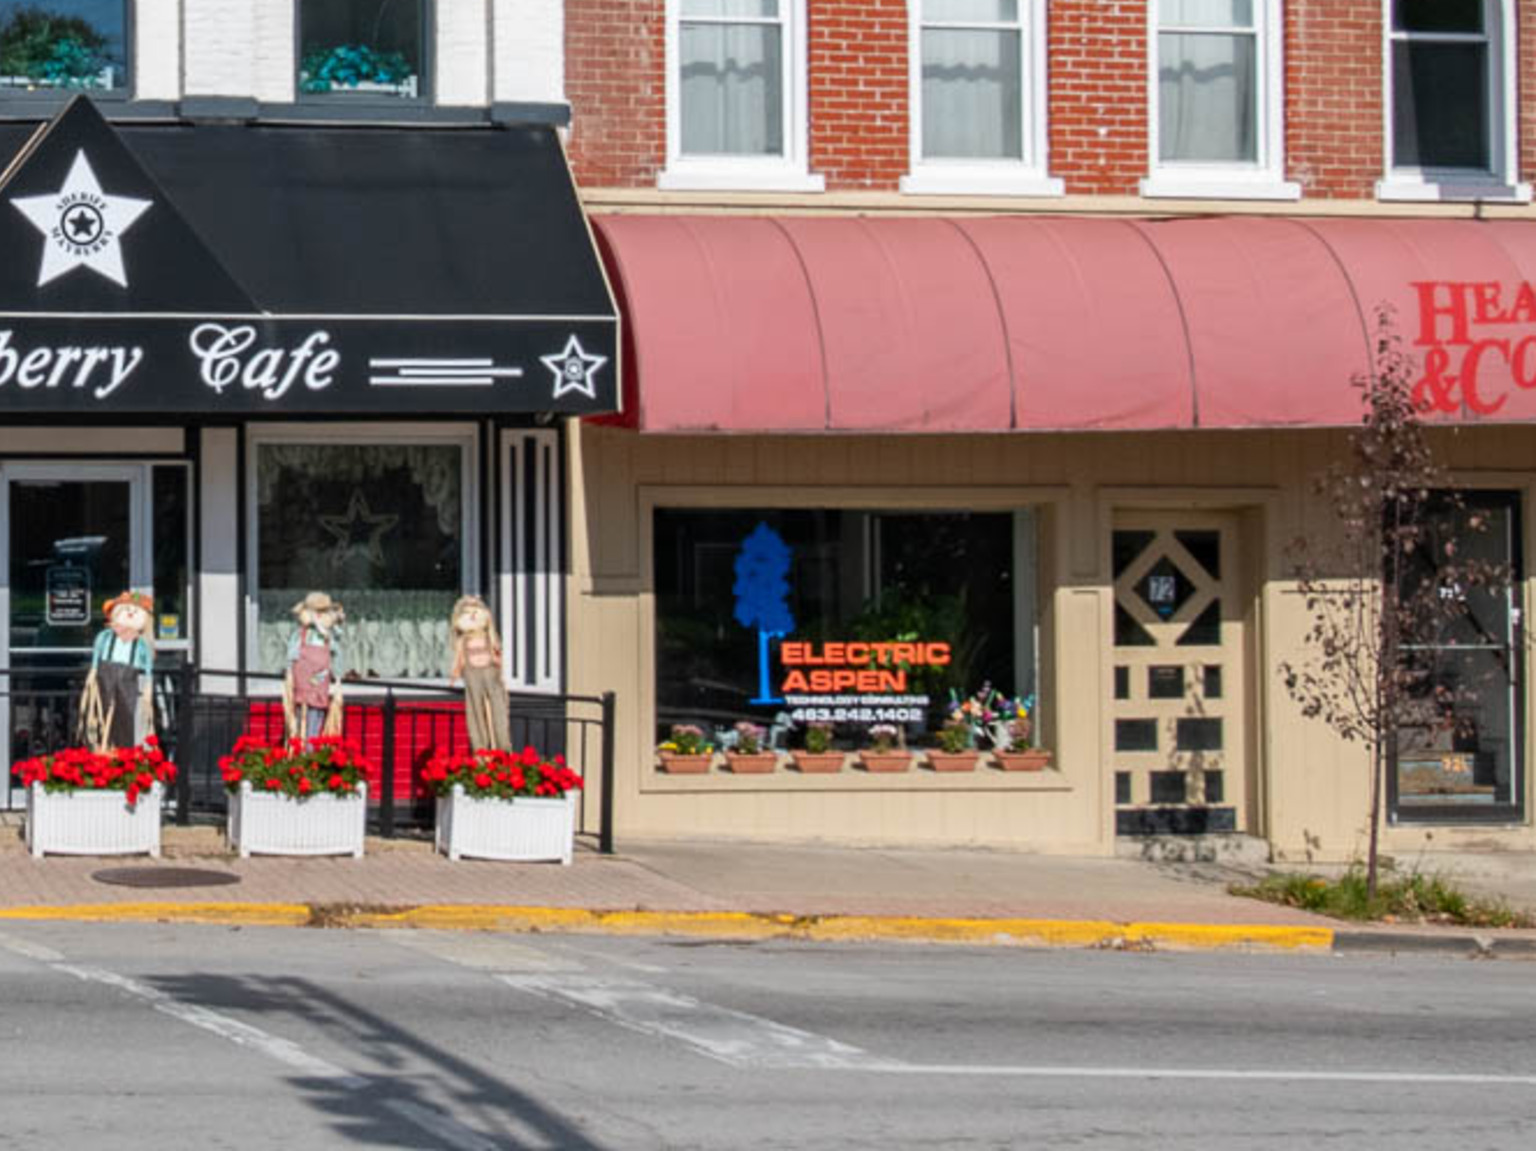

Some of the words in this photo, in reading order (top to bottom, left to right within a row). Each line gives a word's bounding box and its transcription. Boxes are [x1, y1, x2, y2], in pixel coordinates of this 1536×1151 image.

[189, 322, 340, 399] Cafe
[780, 641, 952, 666] ELECTRIC
[781, 668, 908, 693] ASPEN
